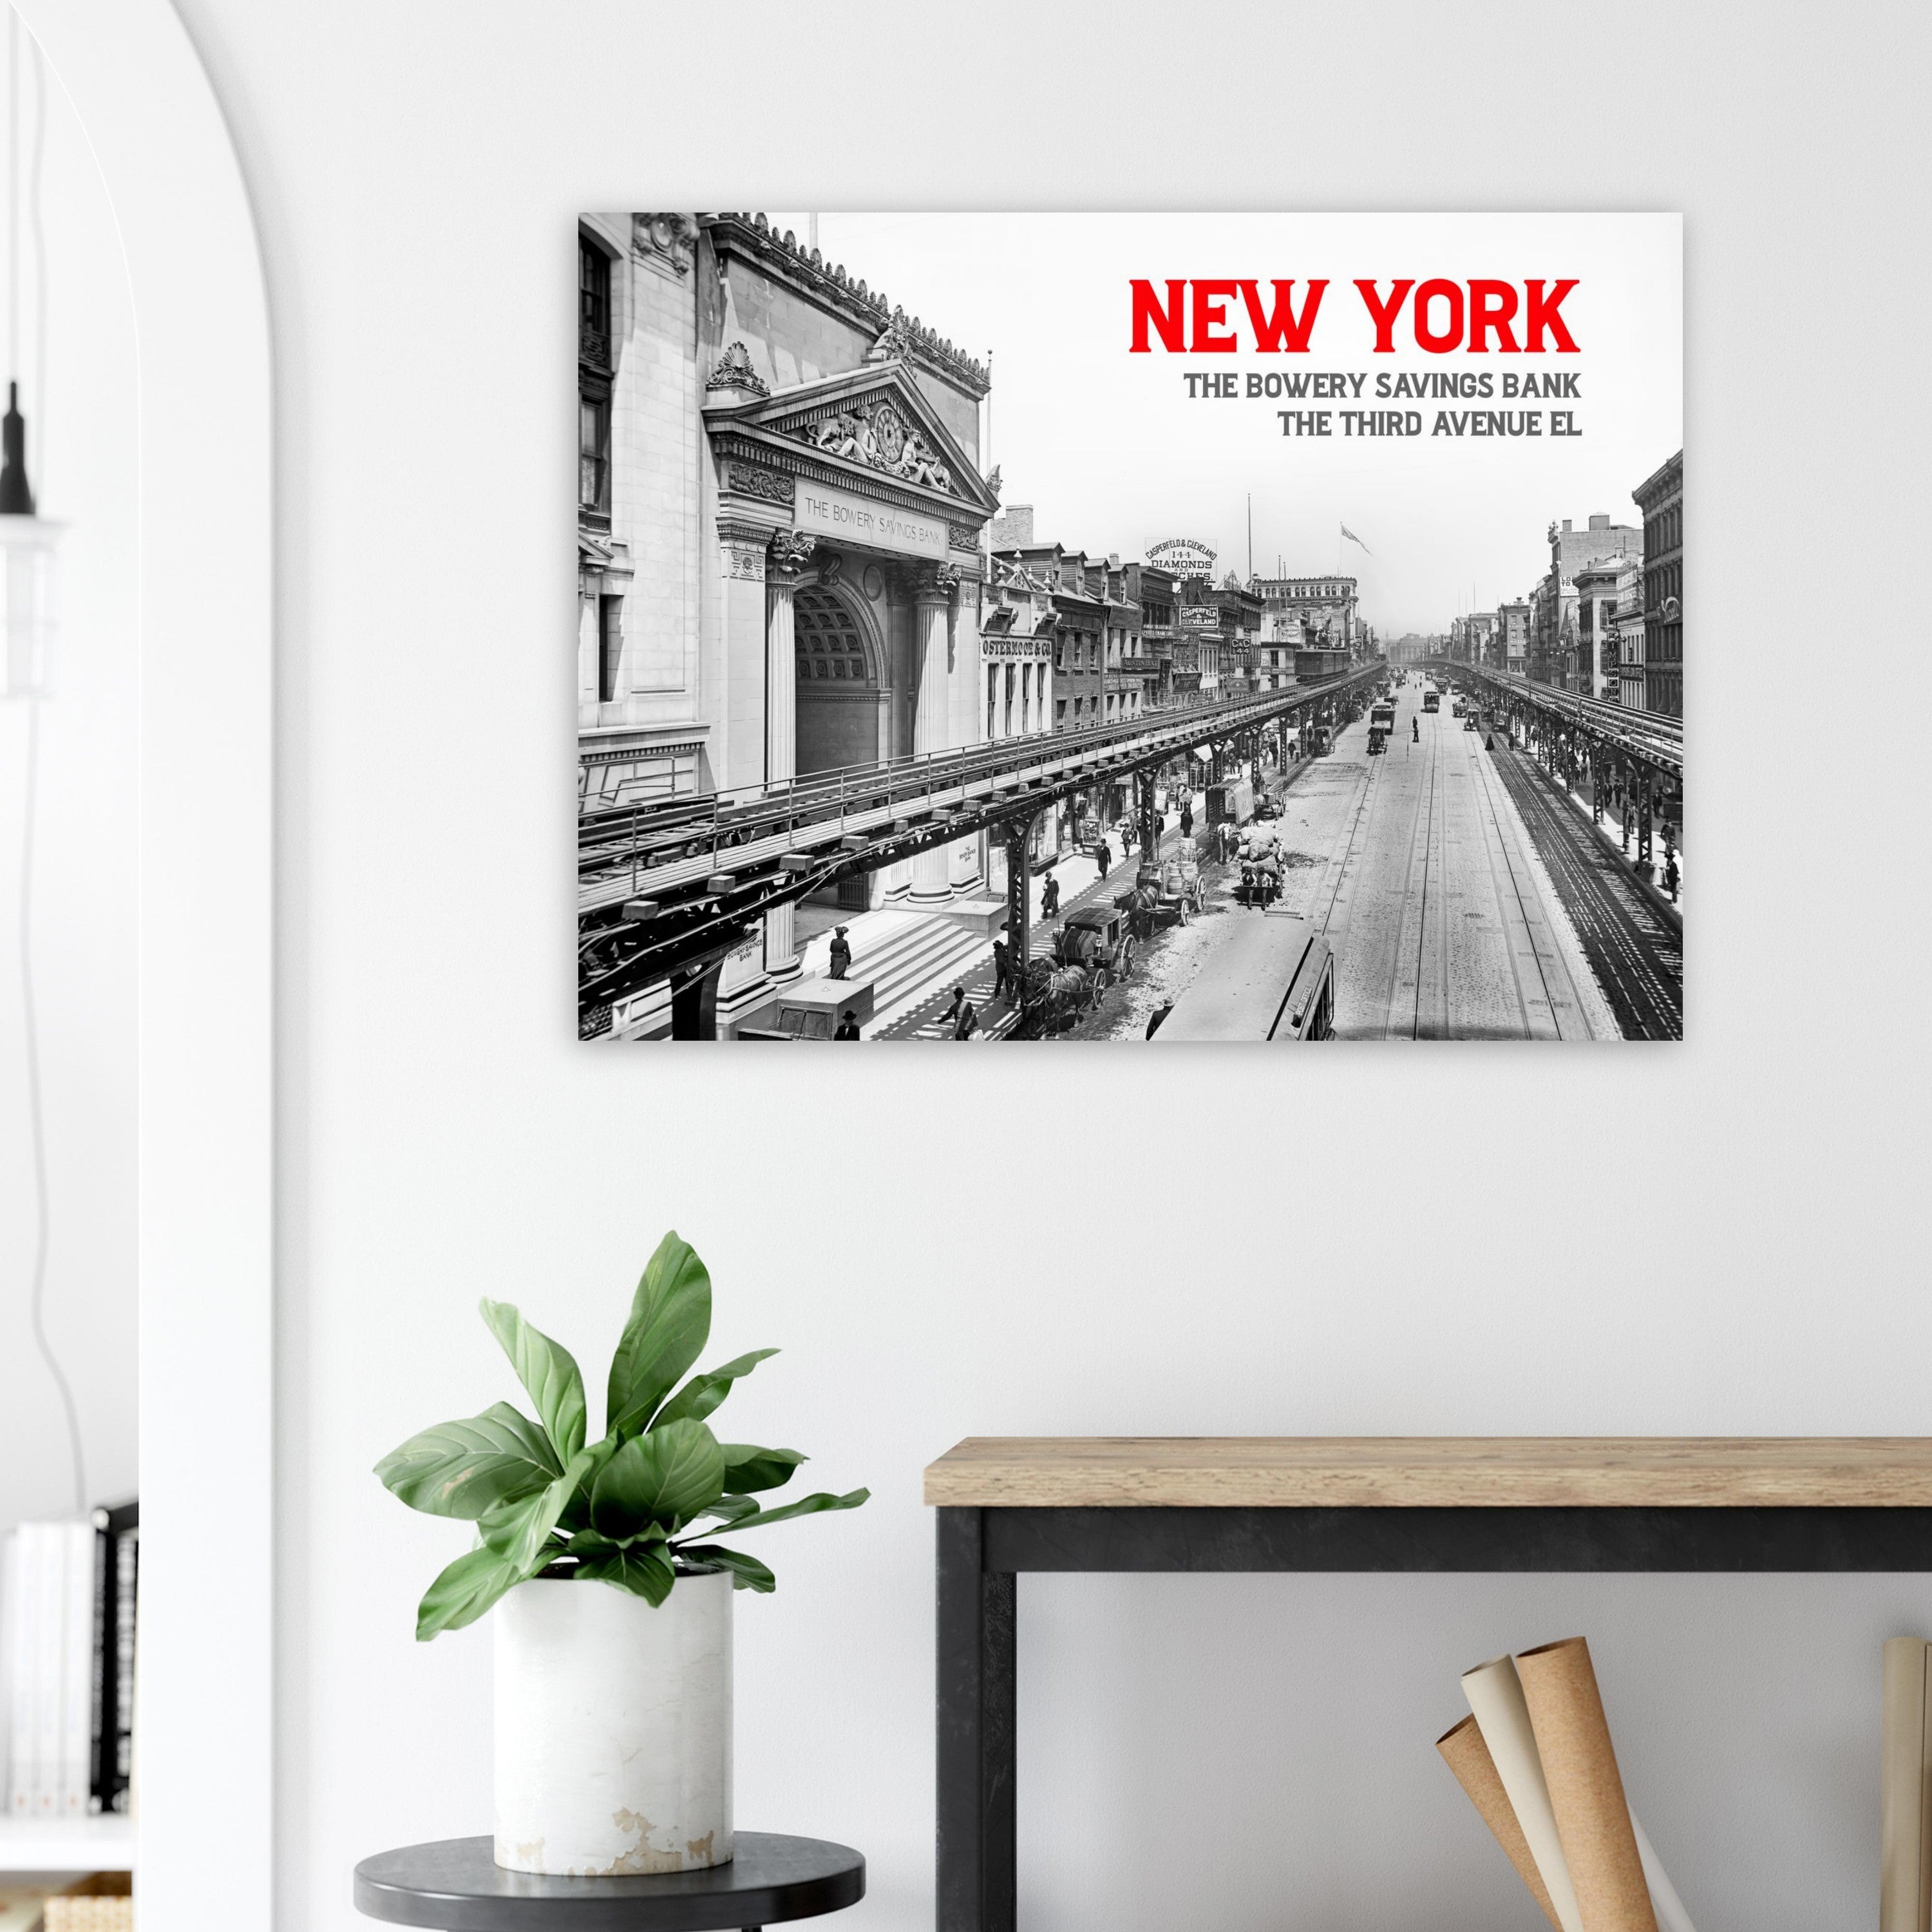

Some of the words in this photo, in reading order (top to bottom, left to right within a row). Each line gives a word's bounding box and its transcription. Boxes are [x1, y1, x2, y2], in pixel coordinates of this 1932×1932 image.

[1129, 279, 1330, 352] NEW
[1352, 278, 1580, 354] YORK
[1184, 373, 1238, 398] THE
[1246, 373, 1367, 399] BOWERY
[1375, 373, 1493, 399] SAVINGS
[1502, 373, 1582, 398] BANK
[1278, 411, 1332, 436] THE
[1340, 411, 1422, 436] THIRD
[1431, 411, 1542, 436] AVENUE
[1550, 411, 1582, 436] EL
[805, 497, 829, 518] THE
[833, 505, 876, 530] BOWERY
[880, 518, 916, 540] SAVINGS
[919, 528, 941, 545] BANK
[1146, 540, 1180, 560] CASPERFELD
[1187, 540, 1217, 561] CLEVELAND
[1151, 560, 1212, 569] DIAMONDS
[1182, 607, 1217, 617] CASPERFELD
[983, 639, 1033, 656] OSTERMOOR
[1034, 642, 1041, 656] &
[1231, 639, 1238, 647] C
[1243, 639, 1250, 647] C
